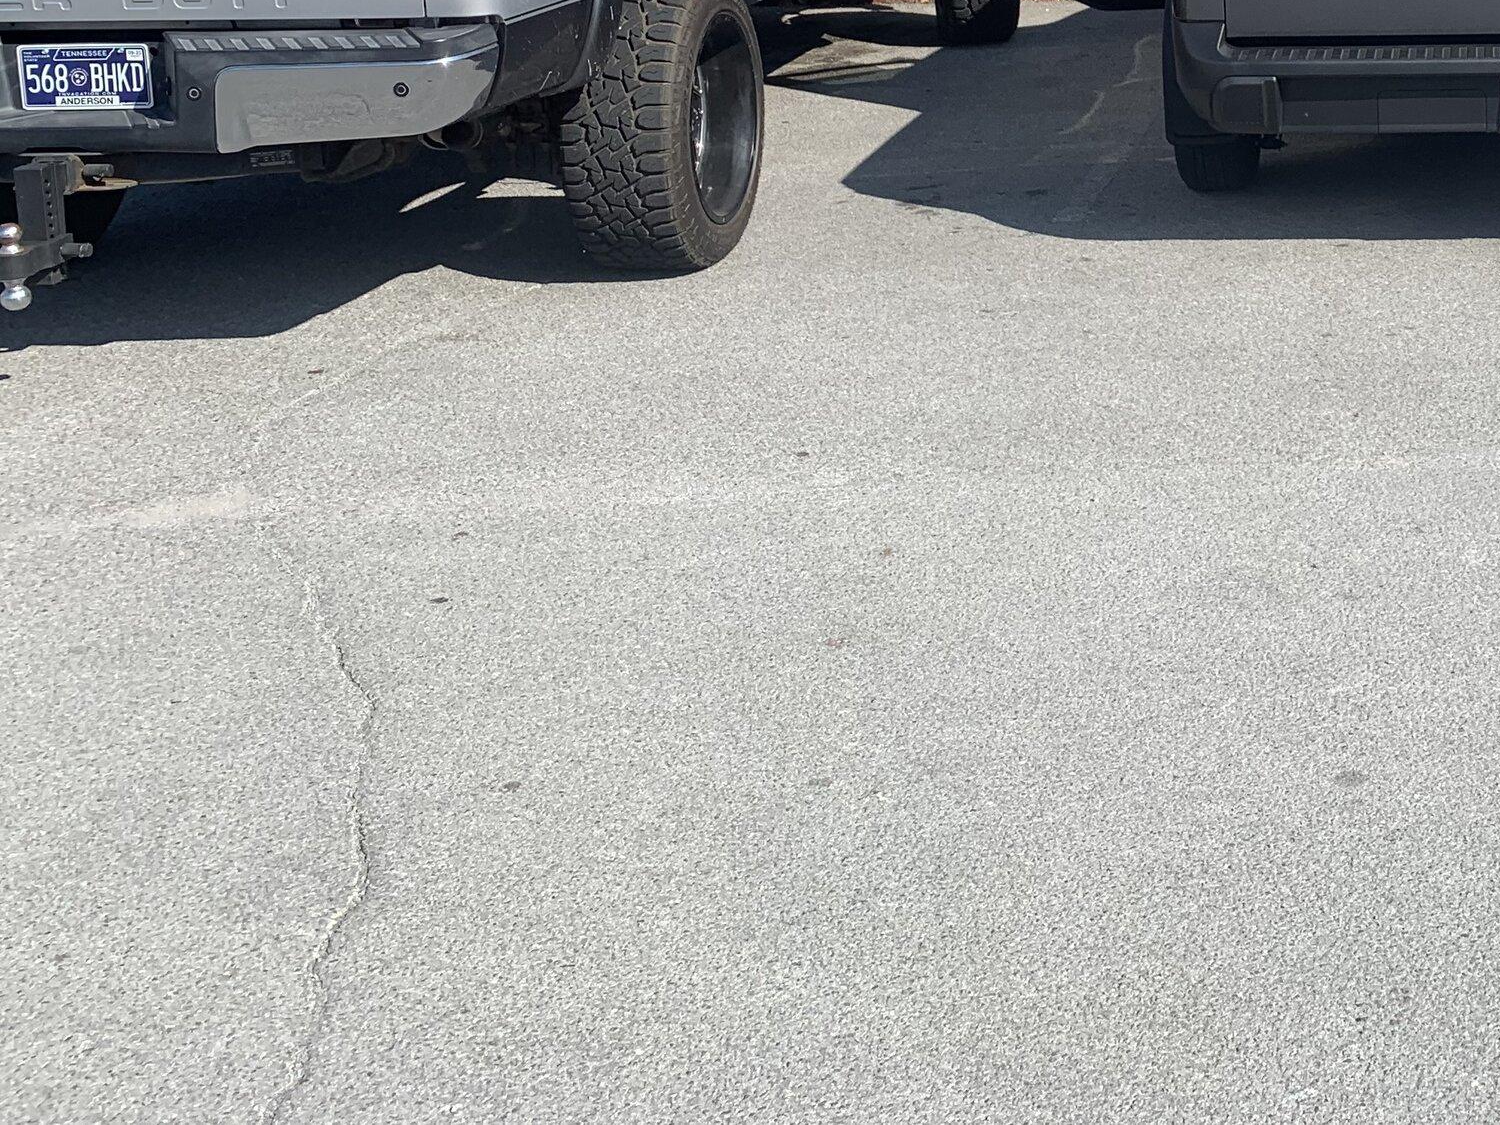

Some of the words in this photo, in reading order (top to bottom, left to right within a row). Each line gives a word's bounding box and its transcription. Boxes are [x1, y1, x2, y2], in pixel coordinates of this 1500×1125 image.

[61, 49, 108, 58] TENNESSEE
[25, 63, 69, 94] 568
[89, 62, 145, 93] BHKD
[60, 97, 114, 106] ANDERSON
